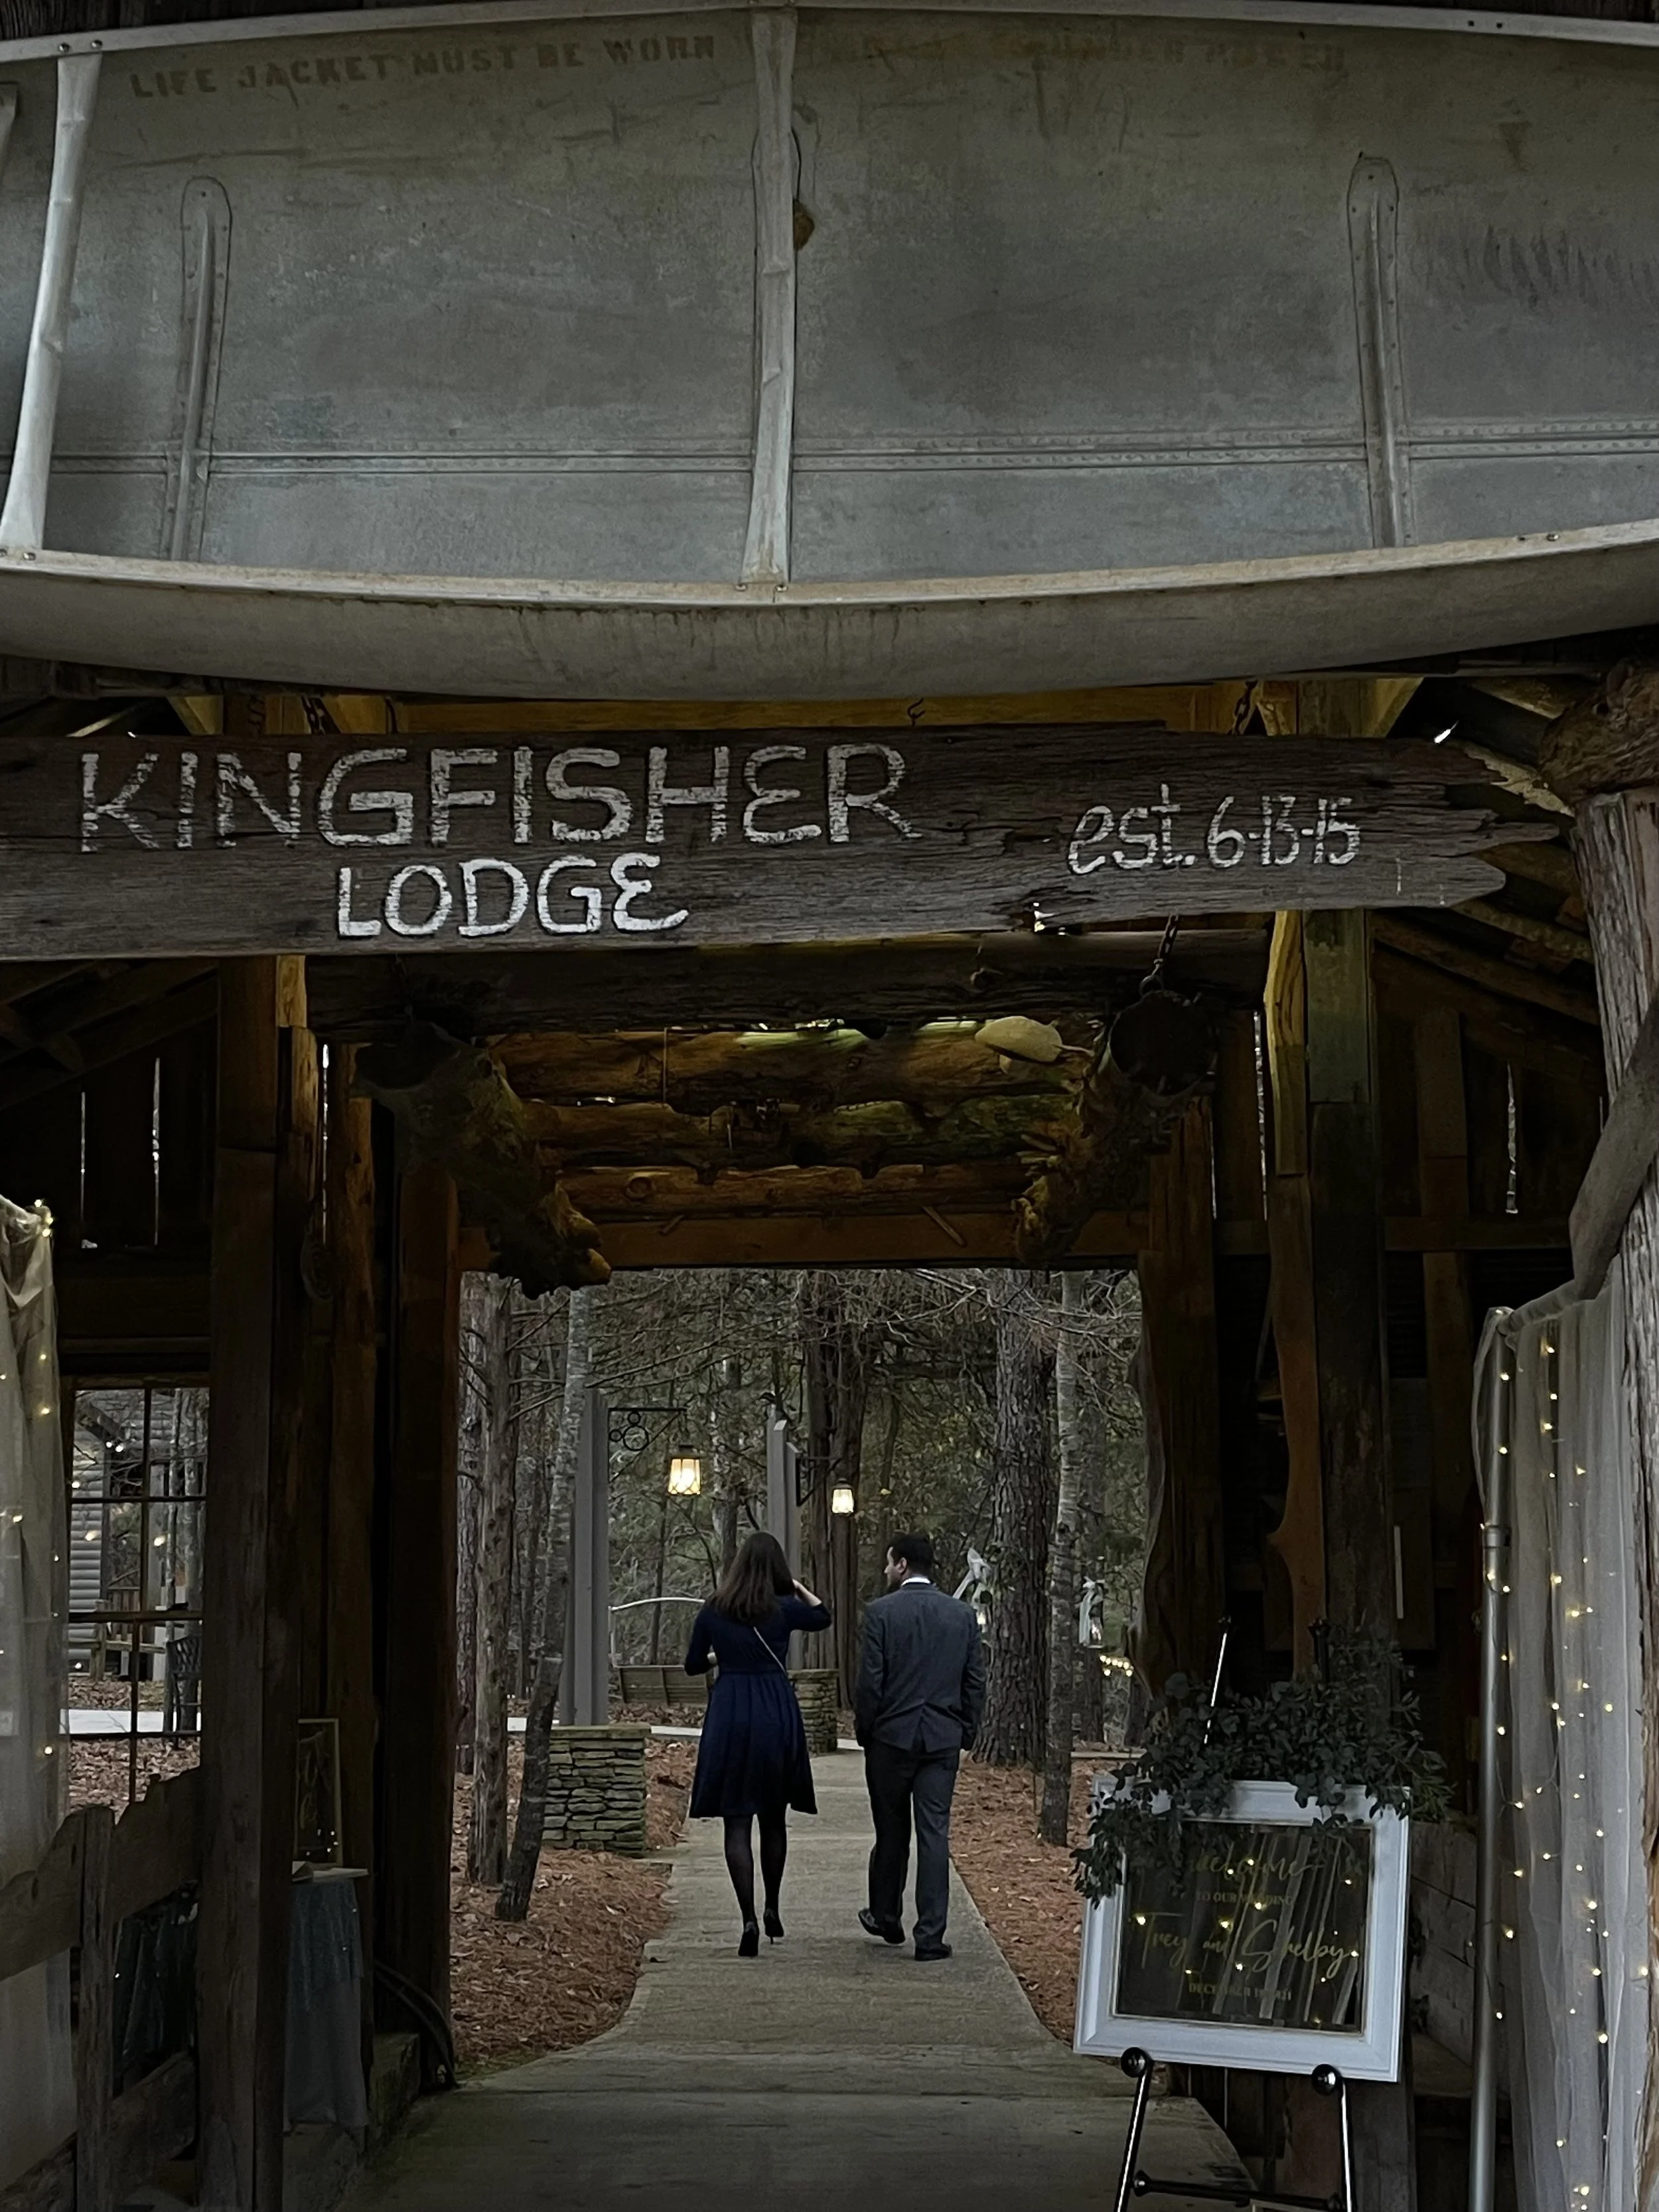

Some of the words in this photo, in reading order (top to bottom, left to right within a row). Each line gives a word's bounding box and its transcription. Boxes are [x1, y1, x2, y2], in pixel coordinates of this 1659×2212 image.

[131, 68, 217, 98] LIFE
[238, 53, 391, 89] JACKET
[412, 43, 520, 76] MUST
[537, 42, 584, 69] BE
[602, 35, 714, 64] WORN
[80, 743, 924, 853] KINGFISHER
[1067, 783, 1195, 875] est.
[336, 853, 689, 937] LODGE
[1133, 1911, 1187, 1970] Trey
[1241, 1918, 1354, 1979] Shelby
